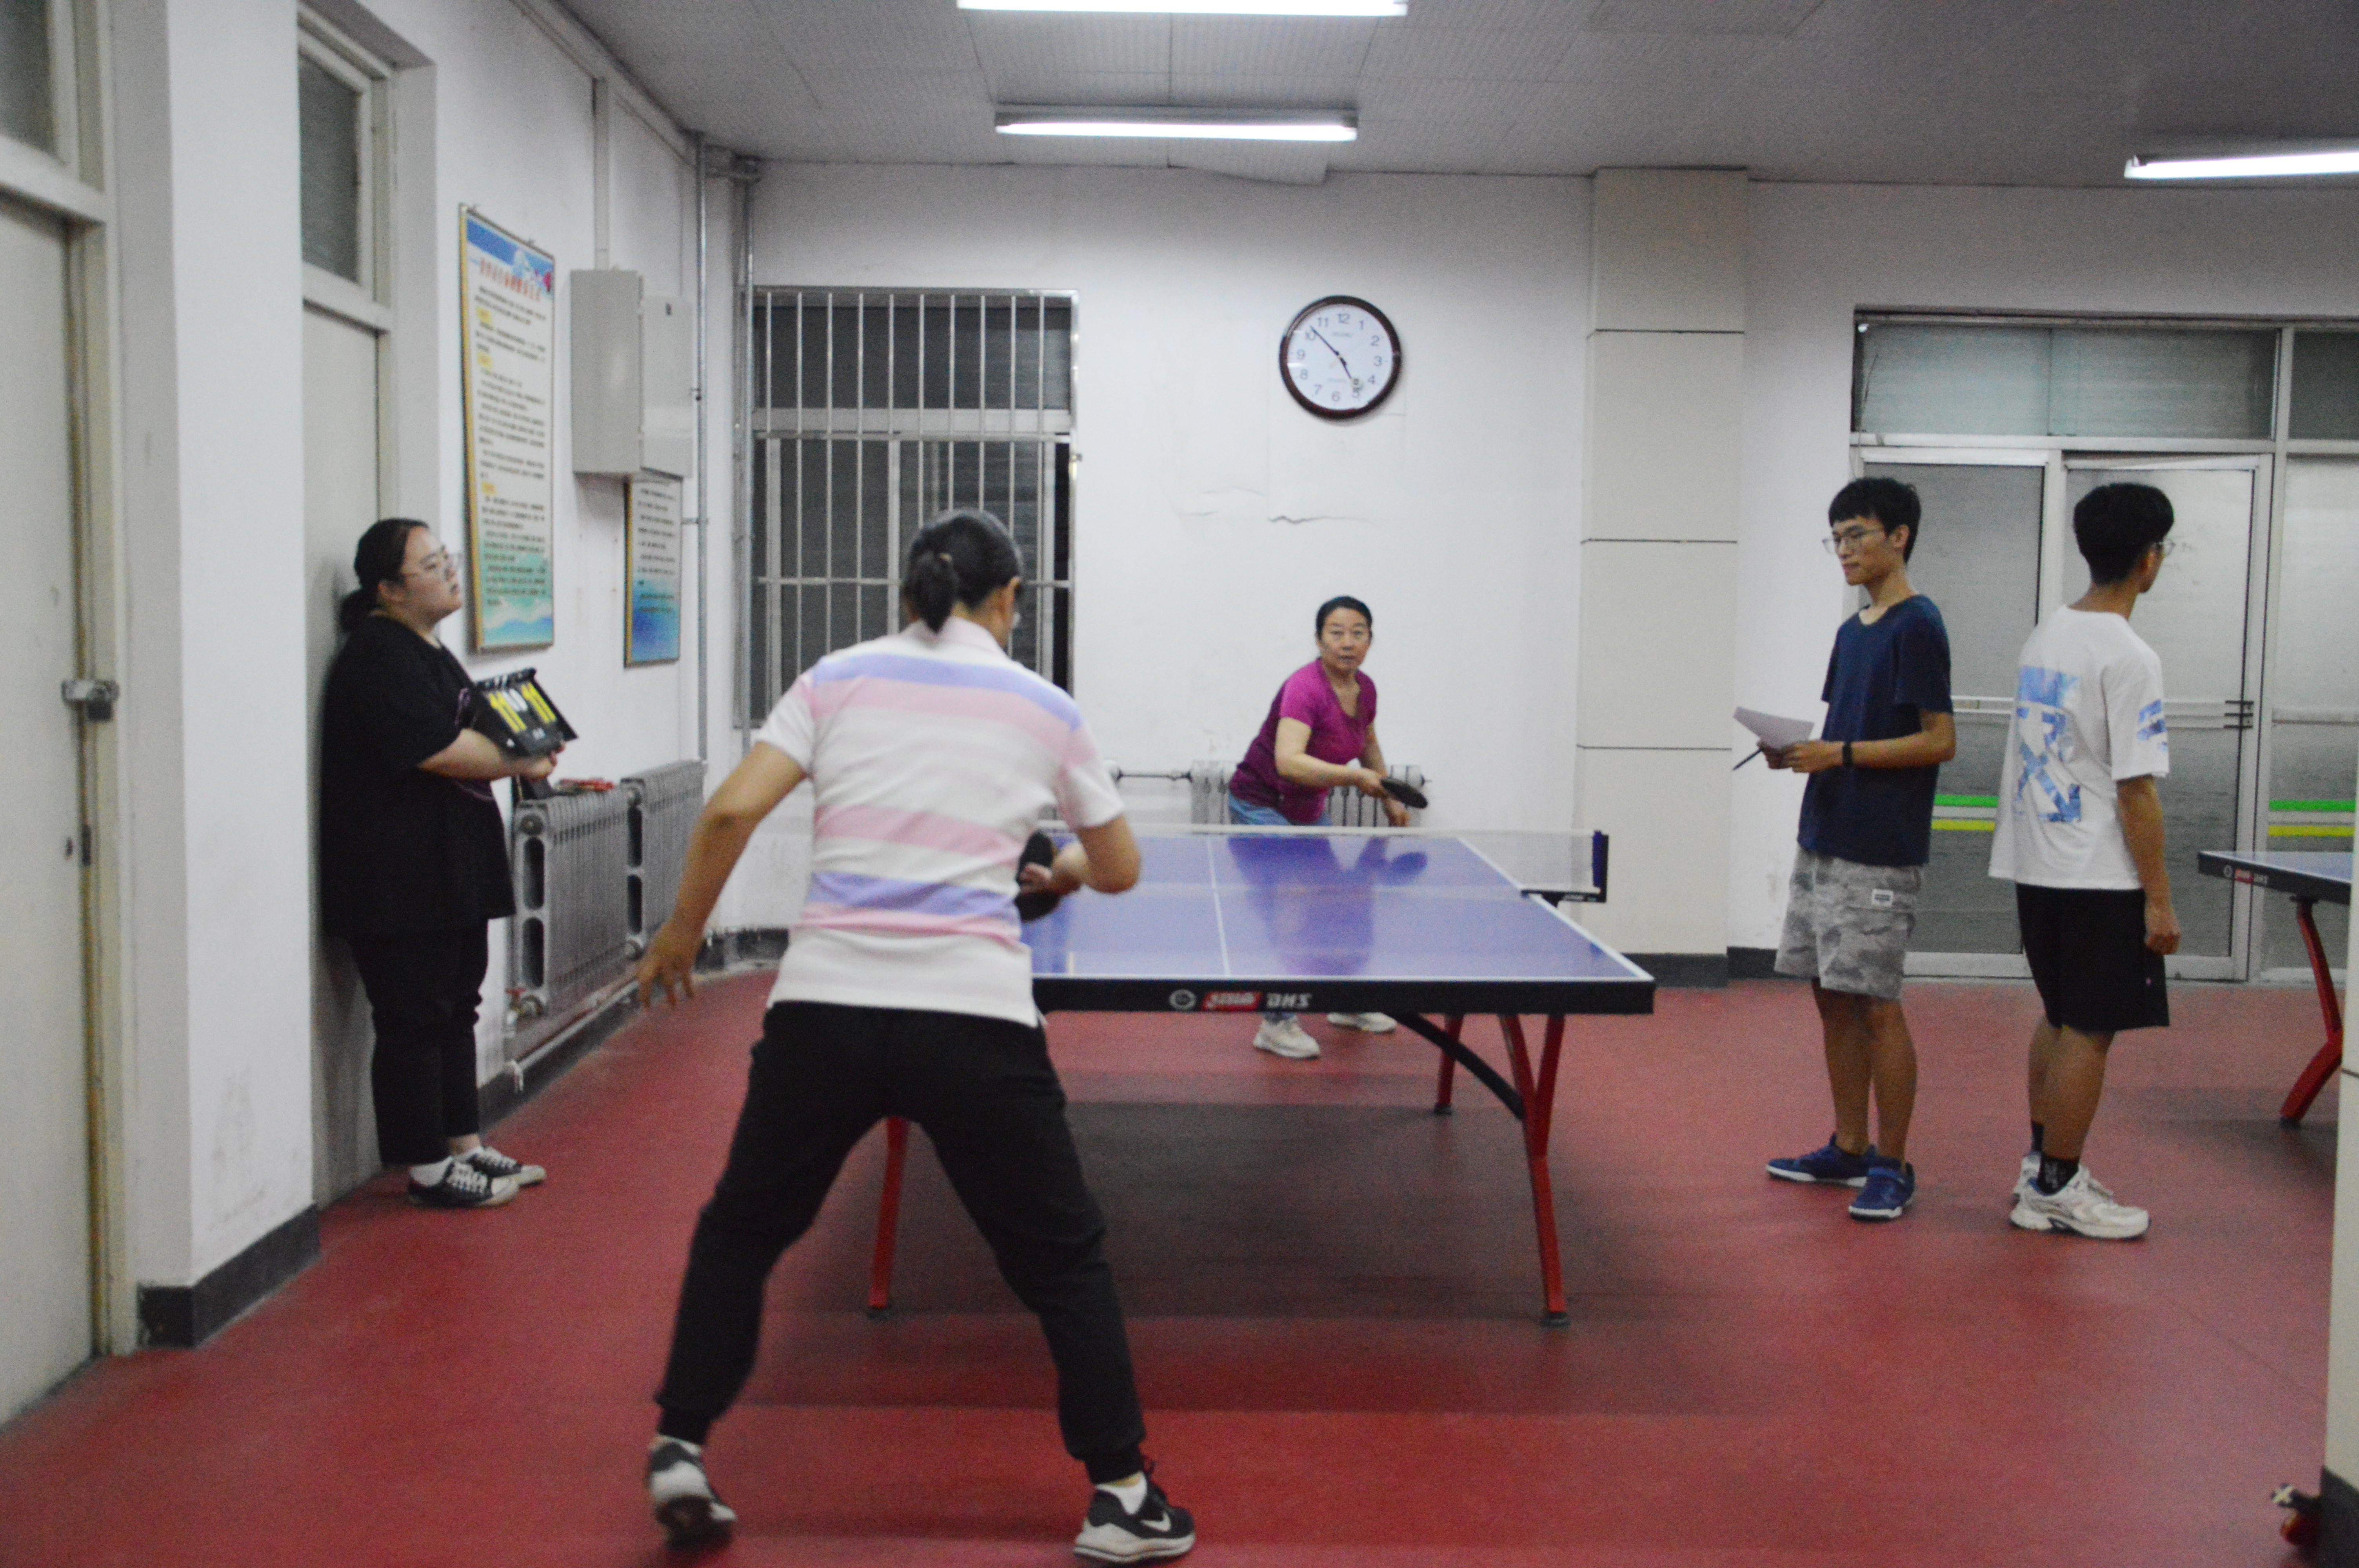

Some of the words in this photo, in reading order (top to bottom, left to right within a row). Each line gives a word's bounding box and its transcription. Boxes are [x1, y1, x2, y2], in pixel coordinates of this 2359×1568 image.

[1318, 317, 1329, 328] 11
[1338, 313, 1350, 324] 12
[1359, 320, 1365, 330] 1
[1370, 335, 1380, 347] 2
[1296, 349, 1306, 360] 9
[1374, 356, 1383, 367] 3
[1300, 368, 1309, 380] 8
[1368, 374, 1375, 385] 4
[1314, 384, 1323, 395] 7
[1331, 391, 1340, 402] 6
[1267, 993, 1312, 1009] DHS
